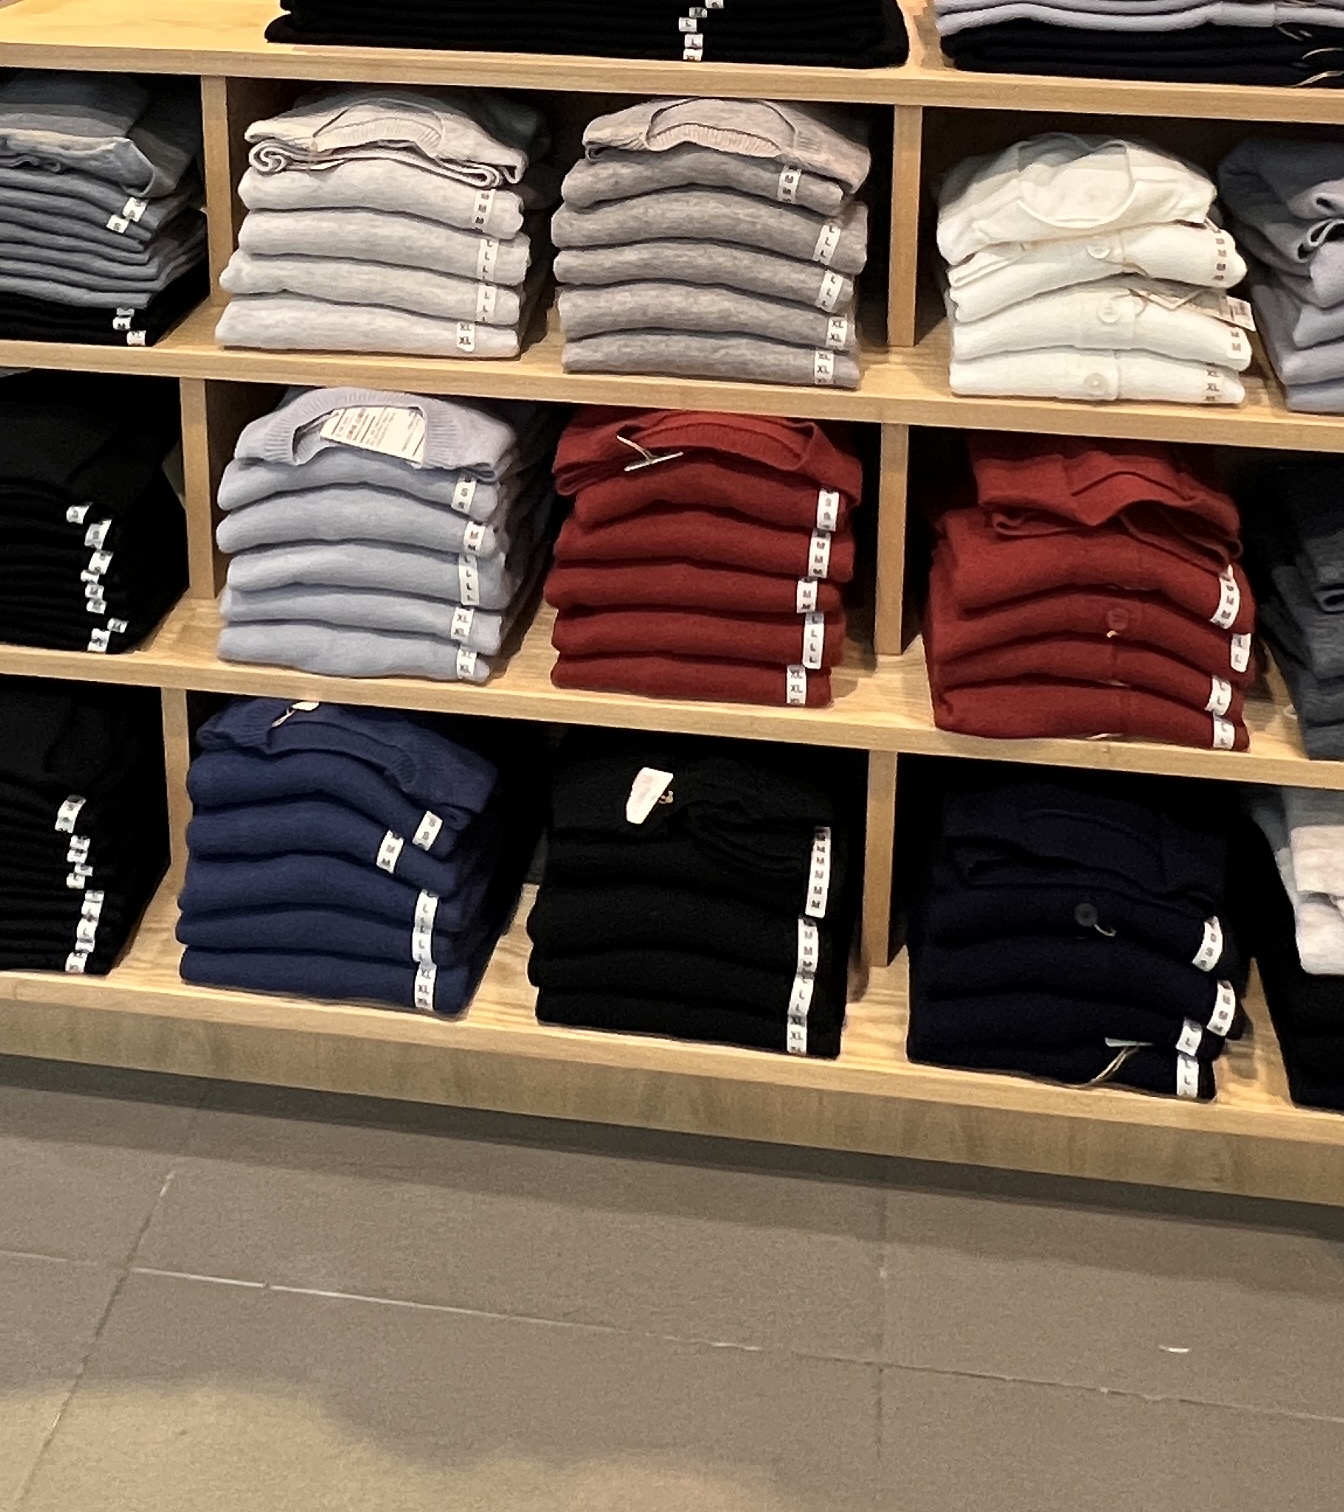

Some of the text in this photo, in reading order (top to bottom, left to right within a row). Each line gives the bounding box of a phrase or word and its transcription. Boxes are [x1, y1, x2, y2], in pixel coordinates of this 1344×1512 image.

[817, 365, 830, 374] XL
[1206, 383, 1220, 392] XL
[456, 614, 469, 624] XL
[790, 684, 804, 693] XL
[790, 1032, 804, 1040] XL
